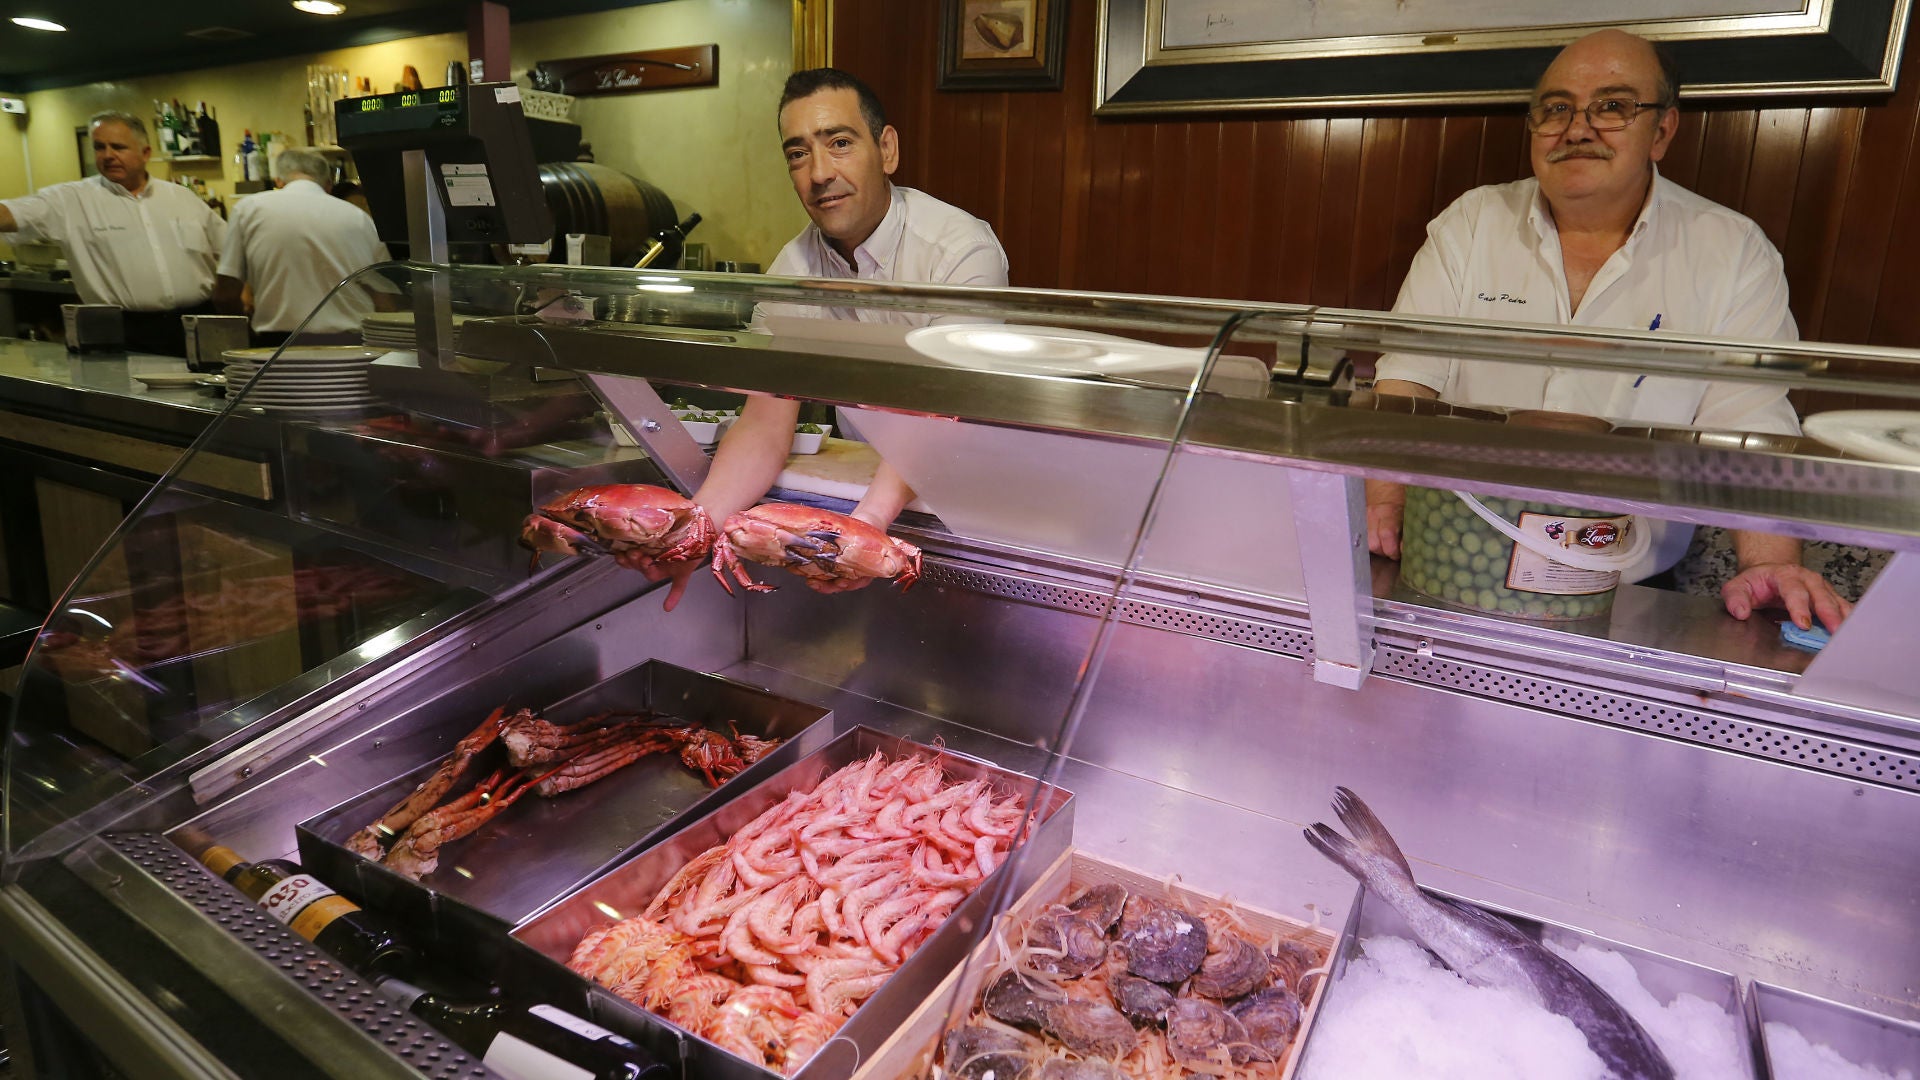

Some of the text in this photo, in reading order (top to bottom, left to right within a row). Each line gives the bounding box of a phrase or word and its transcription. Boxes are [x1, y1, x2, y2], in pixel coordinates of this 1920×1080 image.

[401, 95, 417, 107] 0.00
[439, 90, 455, 103] 0.00
[1581, 531, 1615, 546] Lanzas
